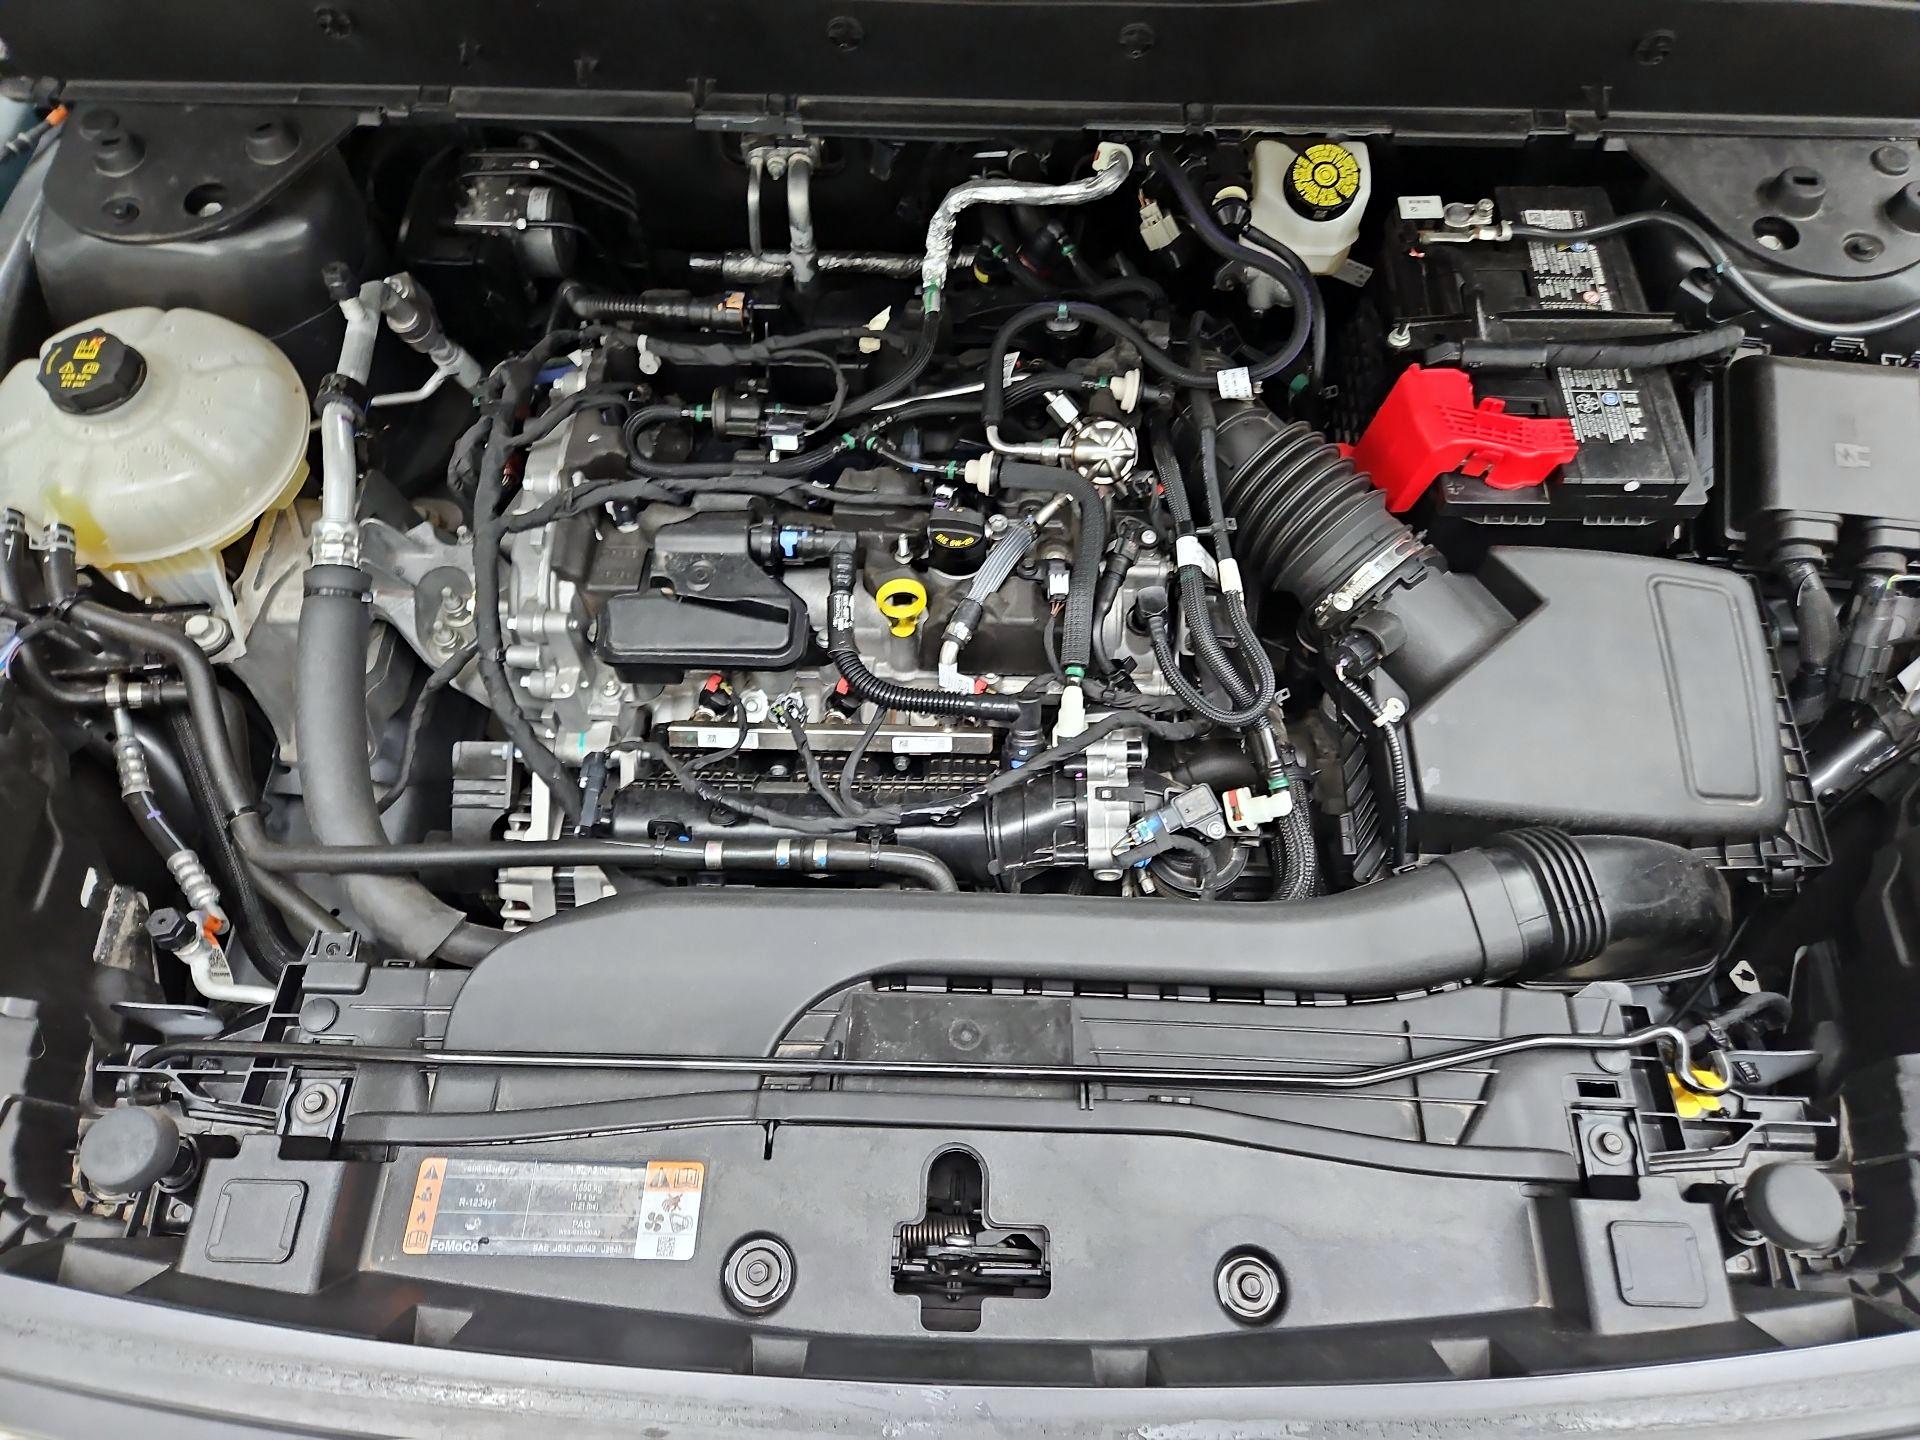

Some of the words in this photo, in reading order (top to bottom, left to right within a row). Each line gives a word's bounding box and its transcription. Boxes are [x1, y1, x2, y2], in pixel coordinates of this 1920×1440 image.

[593, 1183, 603, 1194] kg
[458, 1197, 497, 1210] R-1234yf
[571, 1219, 592, 1229] PAG
[429, 1239, 479, 1252] FoMoCo
